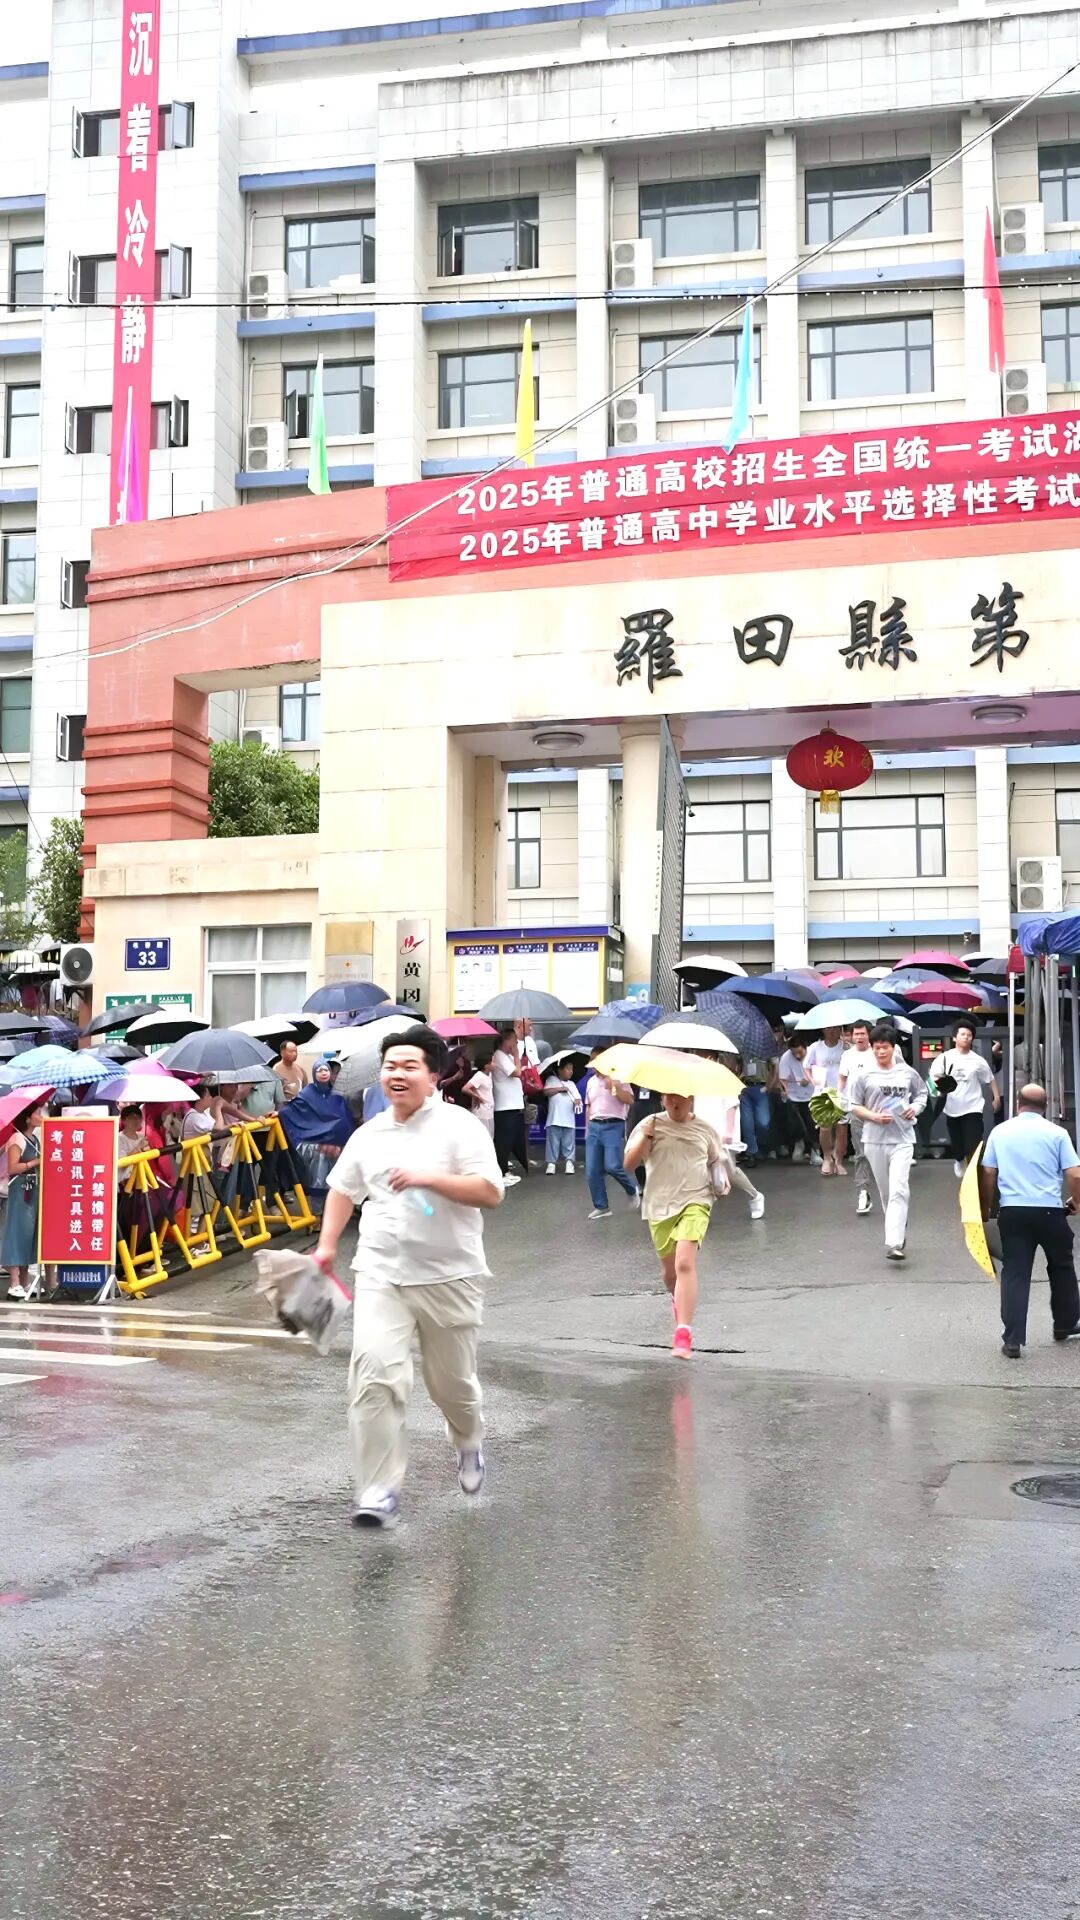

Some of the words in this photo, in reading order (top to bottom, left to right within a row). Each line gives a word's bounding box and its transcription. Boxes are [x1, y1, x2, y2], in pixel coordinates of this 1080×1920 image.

[121, 11, 153, 364] 沉着冷静
[459, 472, 1080, 561] 2025年普通高中学业水平选择性考试
[138, 951, 157, 966] 33
[69, 1130, 86, 1251] 何通讯工具进入
[90, 1165, 106, 1251] 严禁携带任
